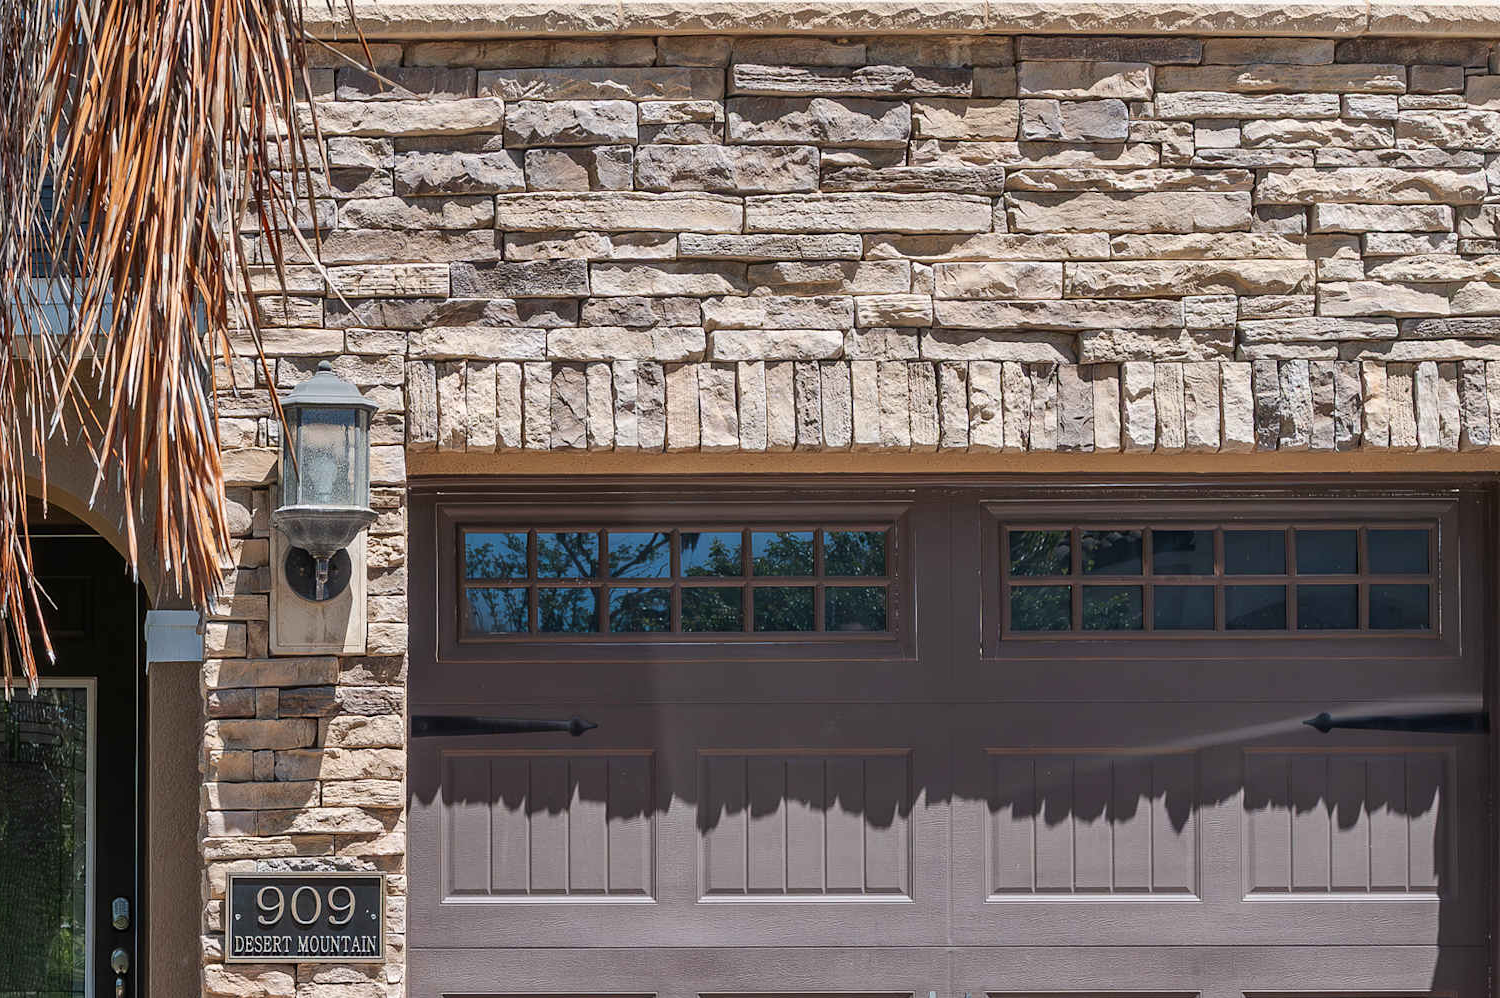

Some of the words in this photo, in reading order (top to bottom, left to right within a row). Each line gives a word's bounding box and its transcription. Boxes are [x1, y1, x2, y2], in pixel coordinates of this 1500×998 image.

[256, 885, 356, 925] 909
[234, 935, 292, 953] DESERT
[298, 935, 377, 953] MOUNTAIN
